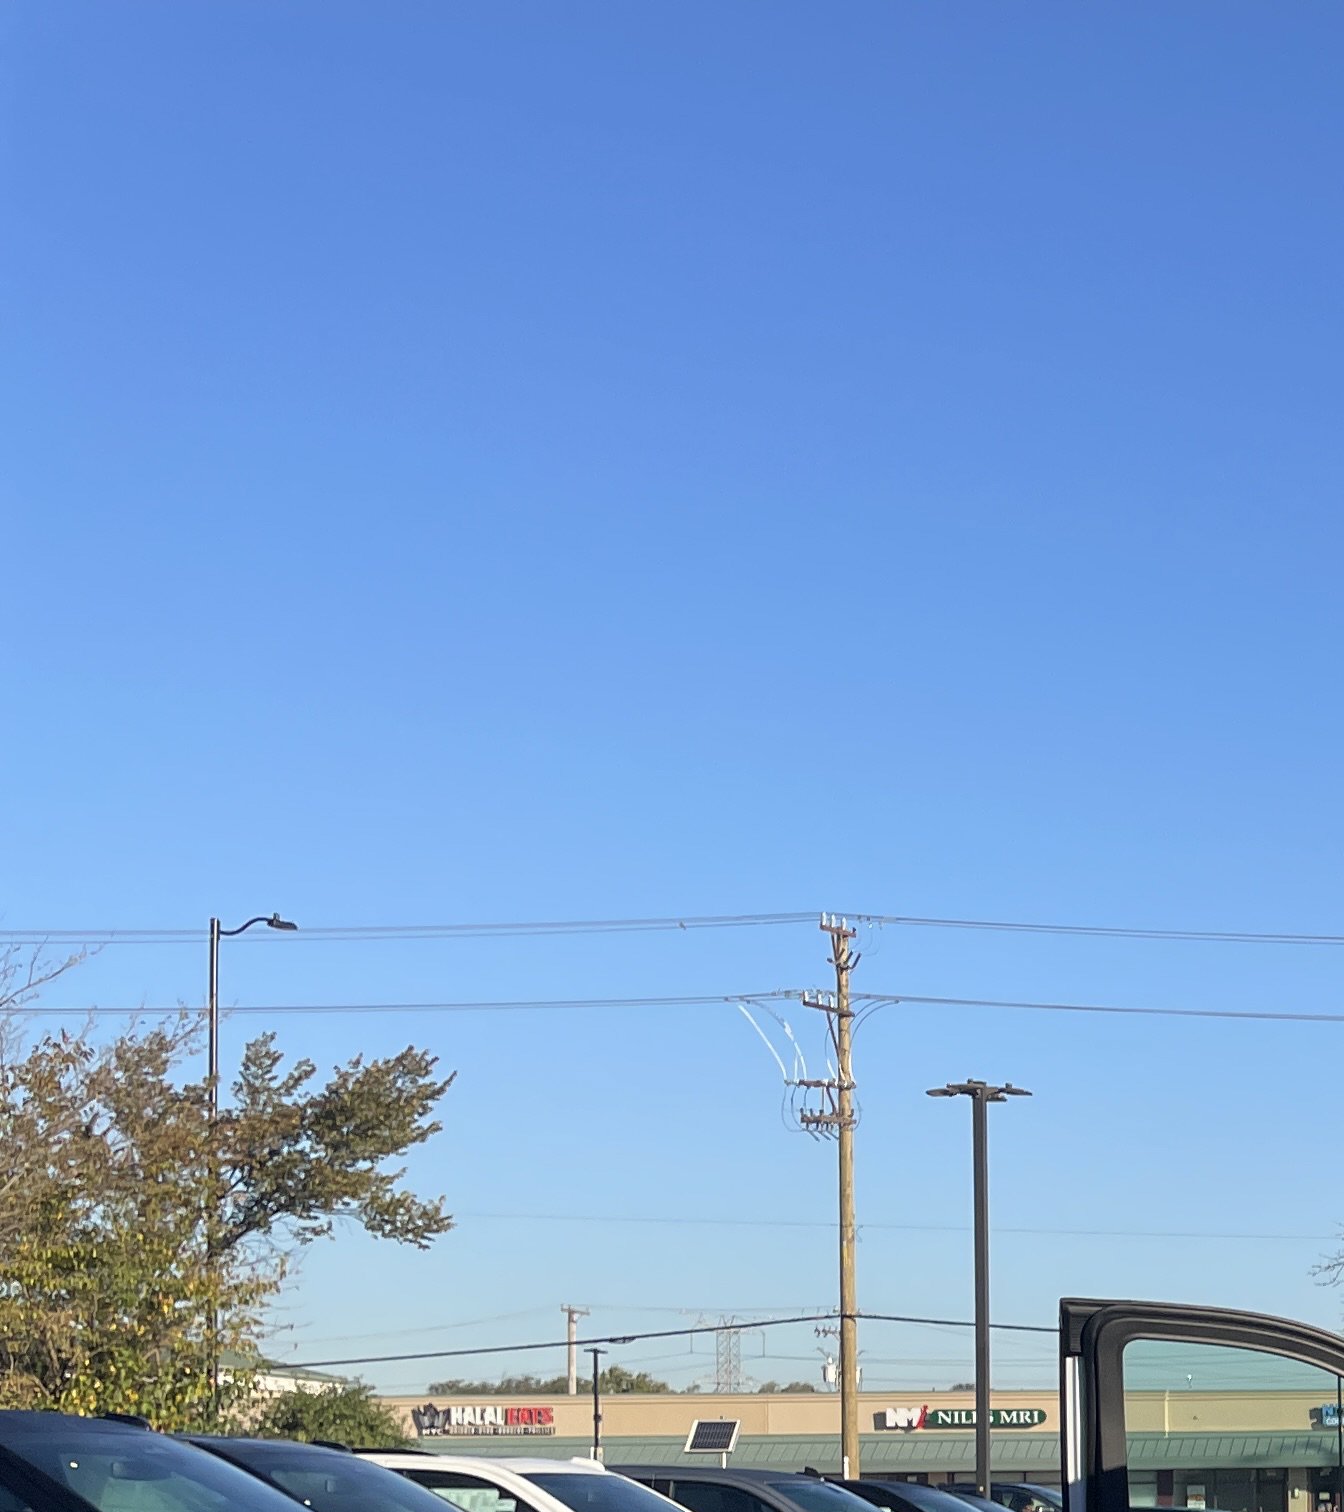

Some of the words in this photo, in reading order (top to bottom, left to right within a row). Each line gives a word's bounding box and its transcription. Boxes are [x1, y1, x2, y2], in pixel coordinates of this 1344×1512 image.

[449, 1406, 505, 1426] HALAL
[506, 1407, 554, 1426] EATS
[999, 1410, 1040, 1425] MRI
